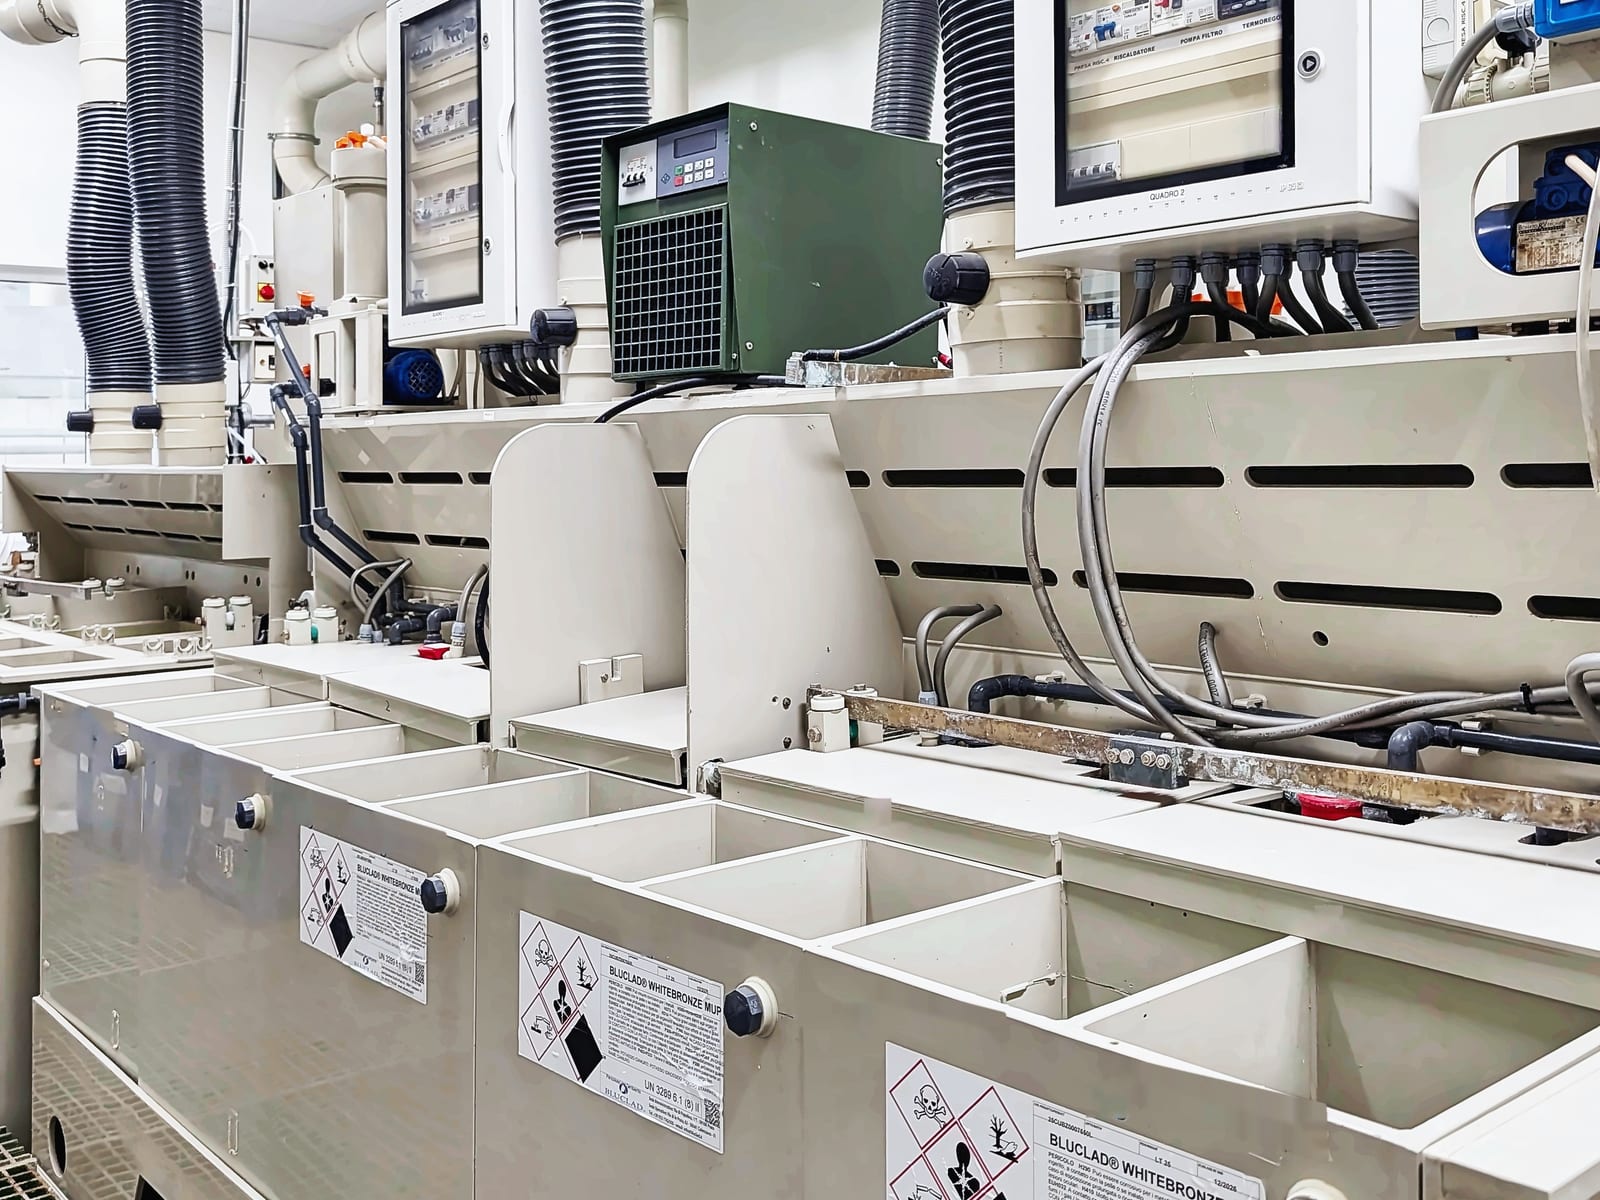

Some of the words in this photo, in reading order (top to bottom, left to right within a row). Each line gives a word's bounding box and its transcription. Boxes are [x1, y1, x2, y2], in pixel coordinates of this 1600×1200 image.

[1180, 35, 1200, 45] POMPA
[1202, 29, 1223, 40] FILTRO
[1114, 46, 1156, 61] RISCALDATORE
[1150, 190, 1179, 201] QUADRO
[385, 699, 391, 712] 2
[609, 965, 647, 988] BLUCLAD®
[648, 979, 703, 1010] WHITEBRONZE
[704, 1001, 722, 1016] MUP
[644, 1079, 655, 1092] UN
[656, 1085, 672, 1099] 3289
[673, 1094, 682, 1105] 6.1
[684, 1098, 694, 1112] (8)
[1048, 1151, 1074, 1166] PERICOLO
[1050, 1133, 1119, 1170] BLUCLAD®
[1122, 1160, 1224, 1200] WHITEBRONZ
